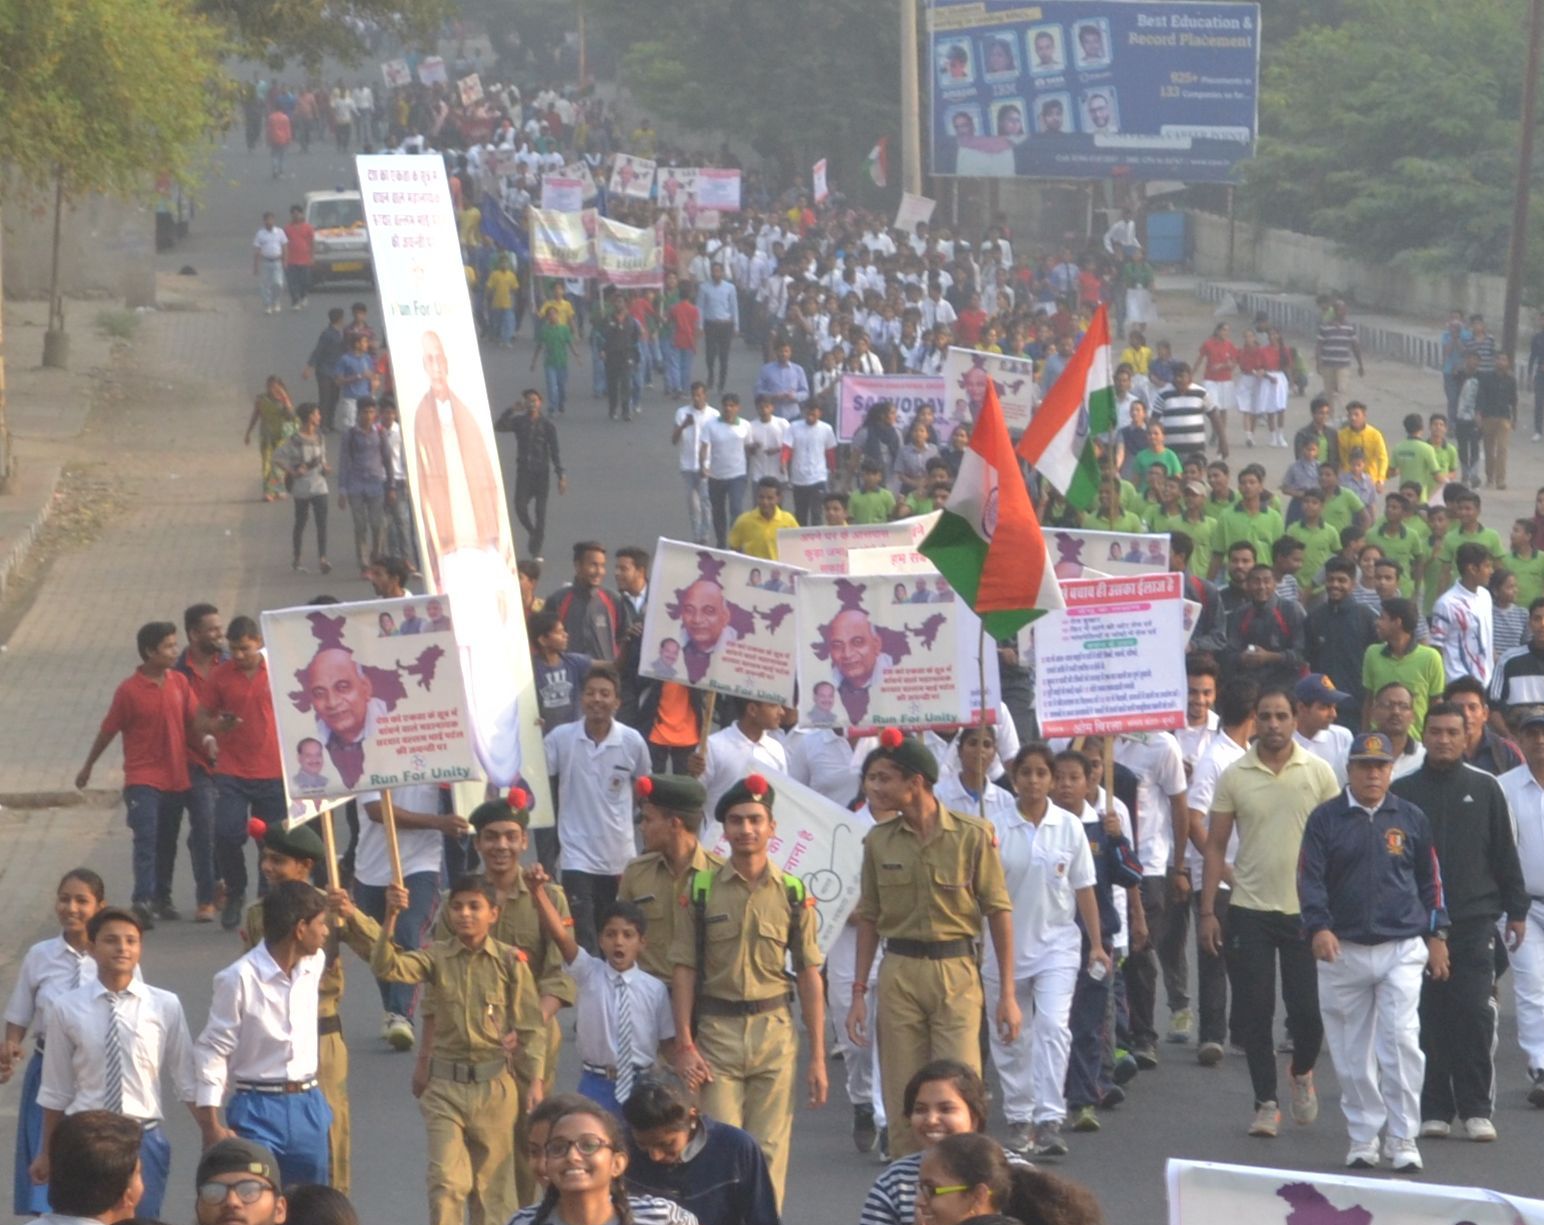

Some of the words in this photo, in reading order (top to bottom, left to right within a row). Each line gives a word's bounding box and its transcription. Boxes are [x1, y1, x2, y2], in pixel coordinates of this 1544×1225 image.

[1137, 14, 1167, 28] Best
[1170, 14, 1241, 29] Education
[1129, 32, 1177, 46] Record
[1179, 32, 1252, 48] Placement
[370, 774, 398, 785] Run
[403, 770, 425, 782] For
[431, 765, 470, 779] Unity
